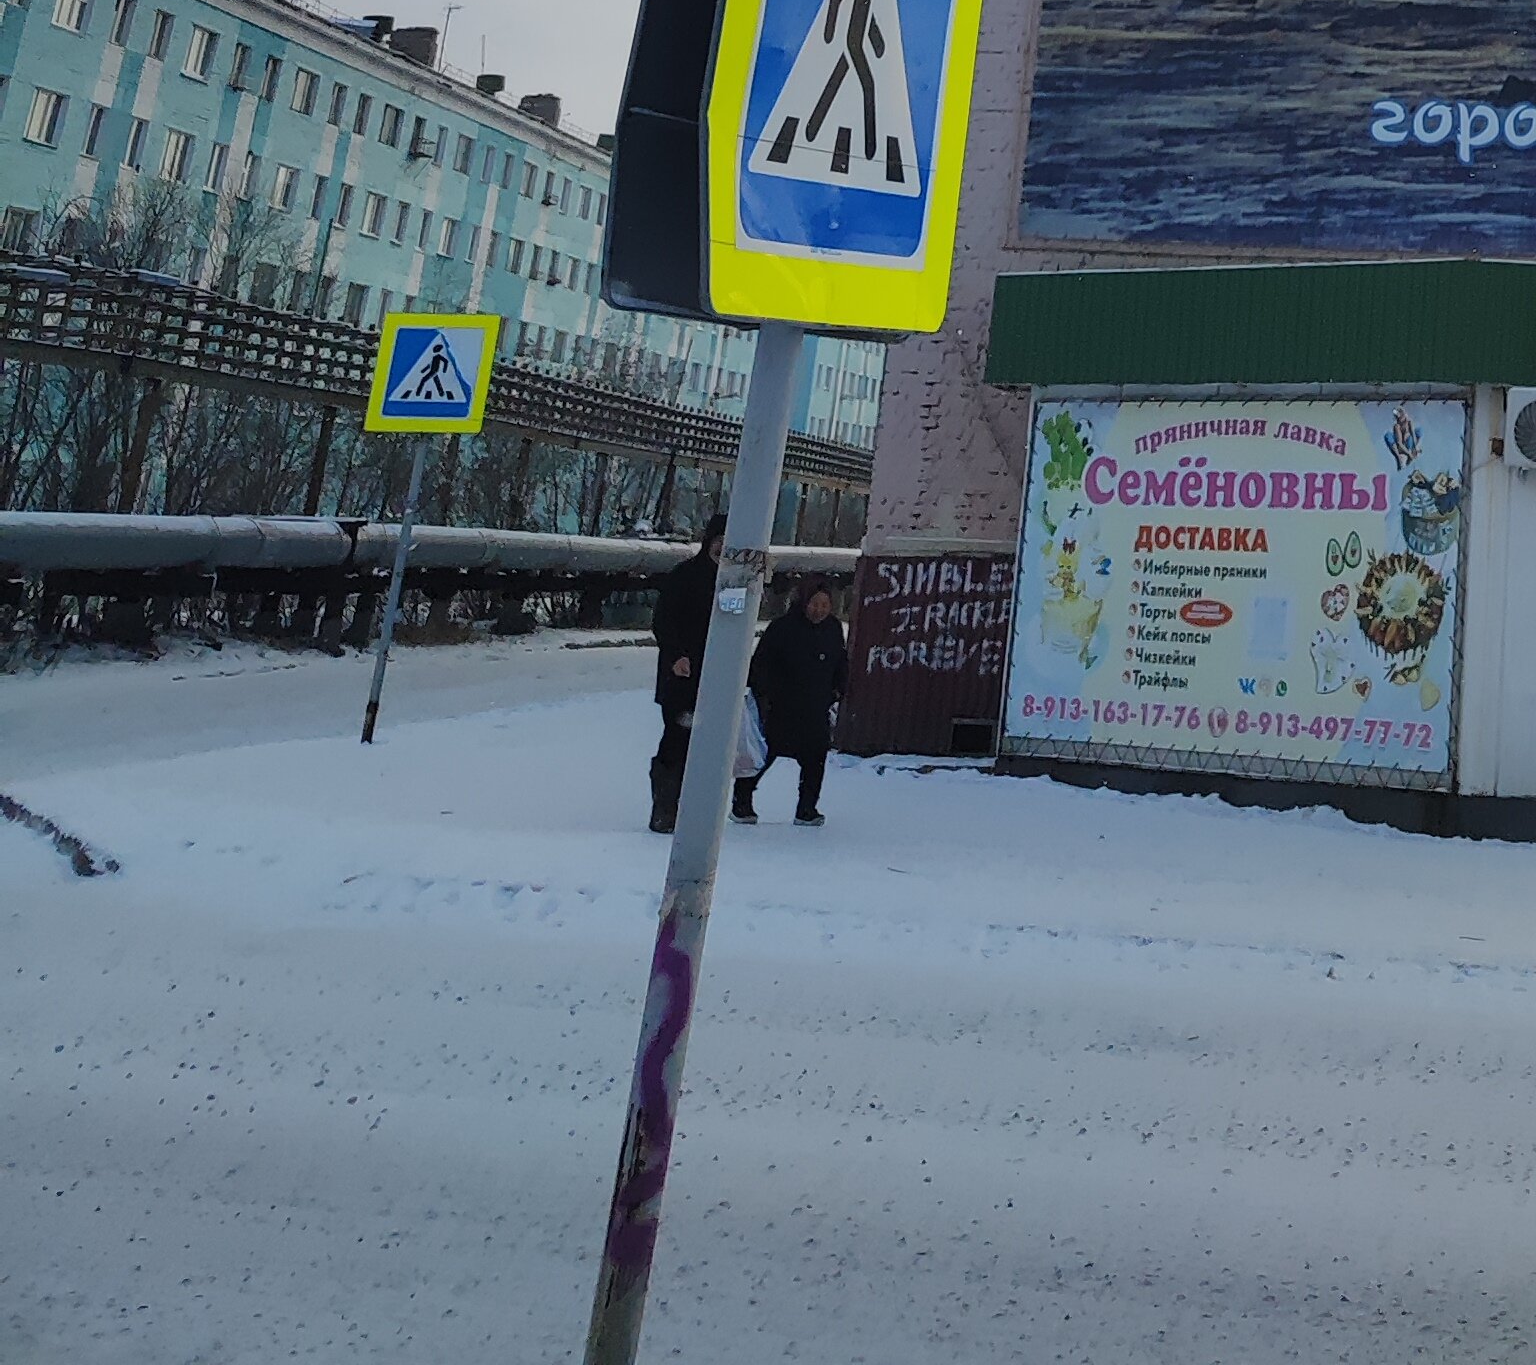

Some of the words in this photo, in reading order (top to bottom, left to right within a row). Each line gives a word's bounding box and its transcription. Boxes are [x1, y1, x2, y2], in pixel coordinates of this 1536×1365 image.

[1134, 418, 1268, 455] пряничная
[1273, 422, 1348, 457] лавка
[1085, 456, 1388, 511] Семёновны
[1133, 524, 1269, 553] ДОСТАВКА
[1142, 558, 1211, 579] Имбирные
[1213, 565, 1267, 581] пряники
[1140, 580, 1202, 599] Капкейки
[1138, 602, 1177, 622] Торты
[1136, 624, 1168, 642] Кейк
[1170, 632, 1212, 645] попсы
[1134, 647, 1197, 667] Чизкейки
[1132, 669, 1190, 692] Трайфлы
[1022, 694, 1201, 730] 8-913-163-17-76
[1234, 709, 1433, 751] 8-913-497-77-72
